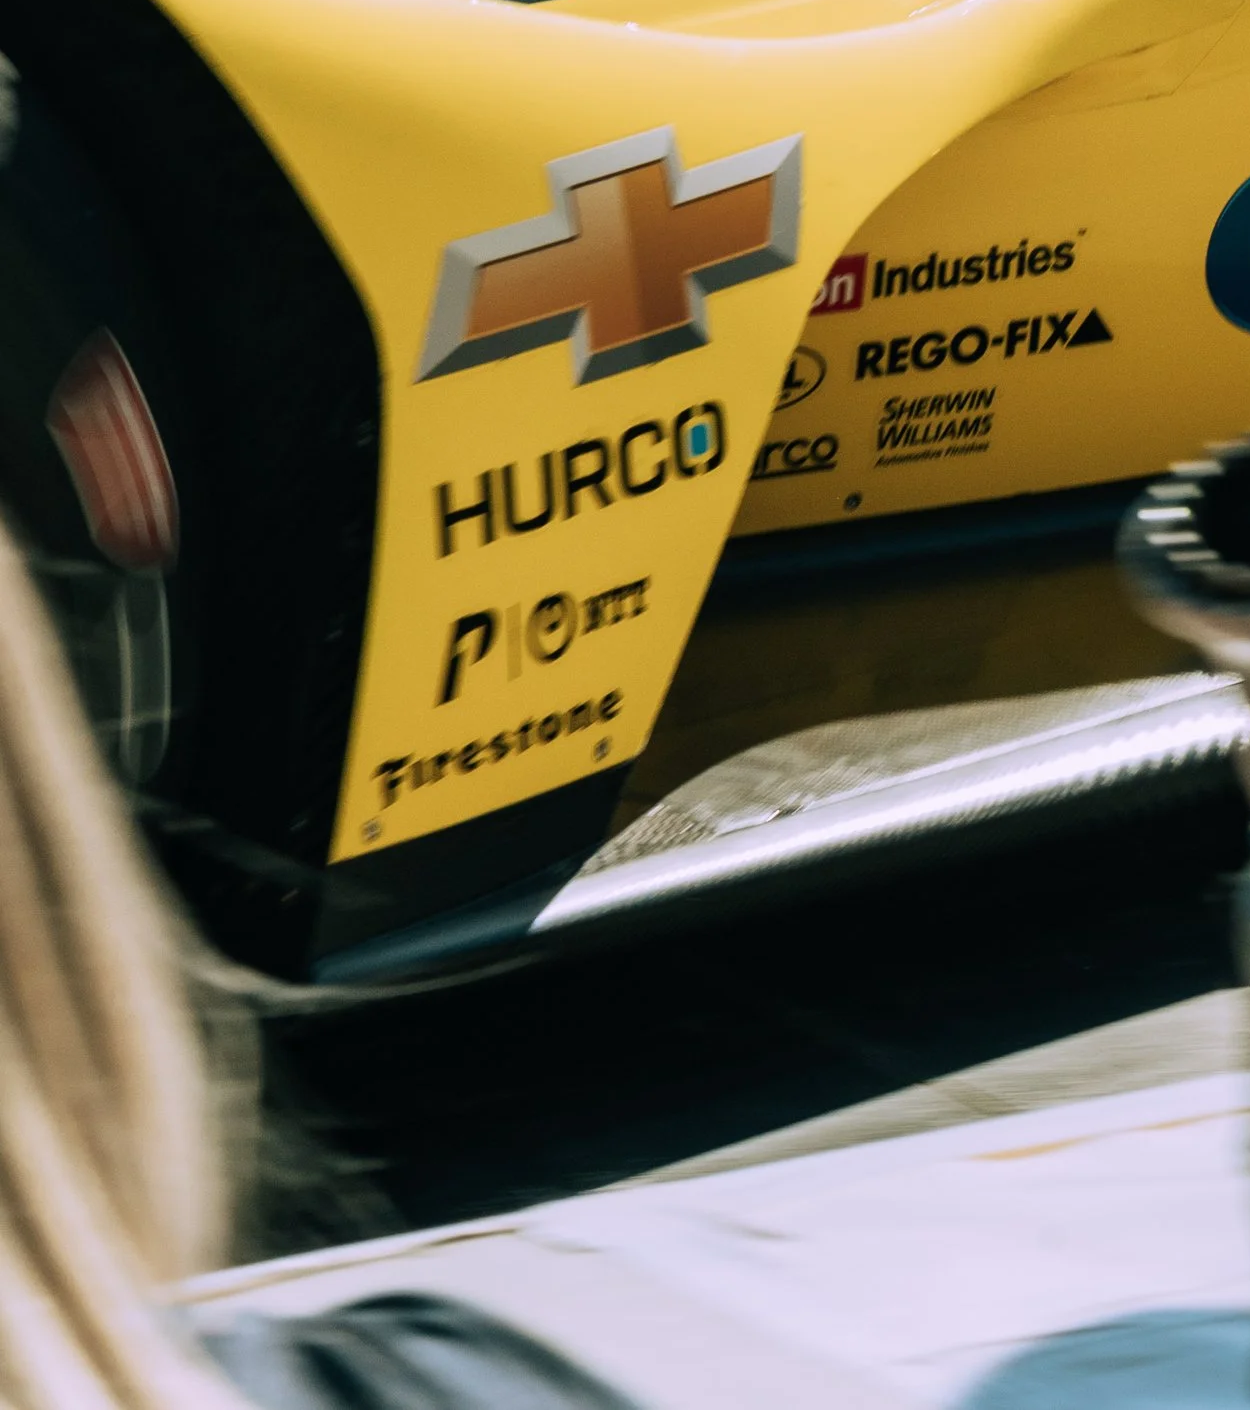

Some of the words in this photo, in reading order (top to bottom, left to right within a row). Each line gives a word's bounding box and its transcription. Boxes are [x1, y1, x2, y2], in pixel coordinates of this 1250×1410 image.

[871, 238, 1076, 300] Industries
[854, 309, 1079, 382] REGO-FIX
[876, 412, 995, 452] WILLIAMS
[880, 385, 997, 424] SHERWIN
[433, 399, 728, 560] HURCO
[752, 432, 840, 476] rco
[368, 686, 625, 812] Firestone
